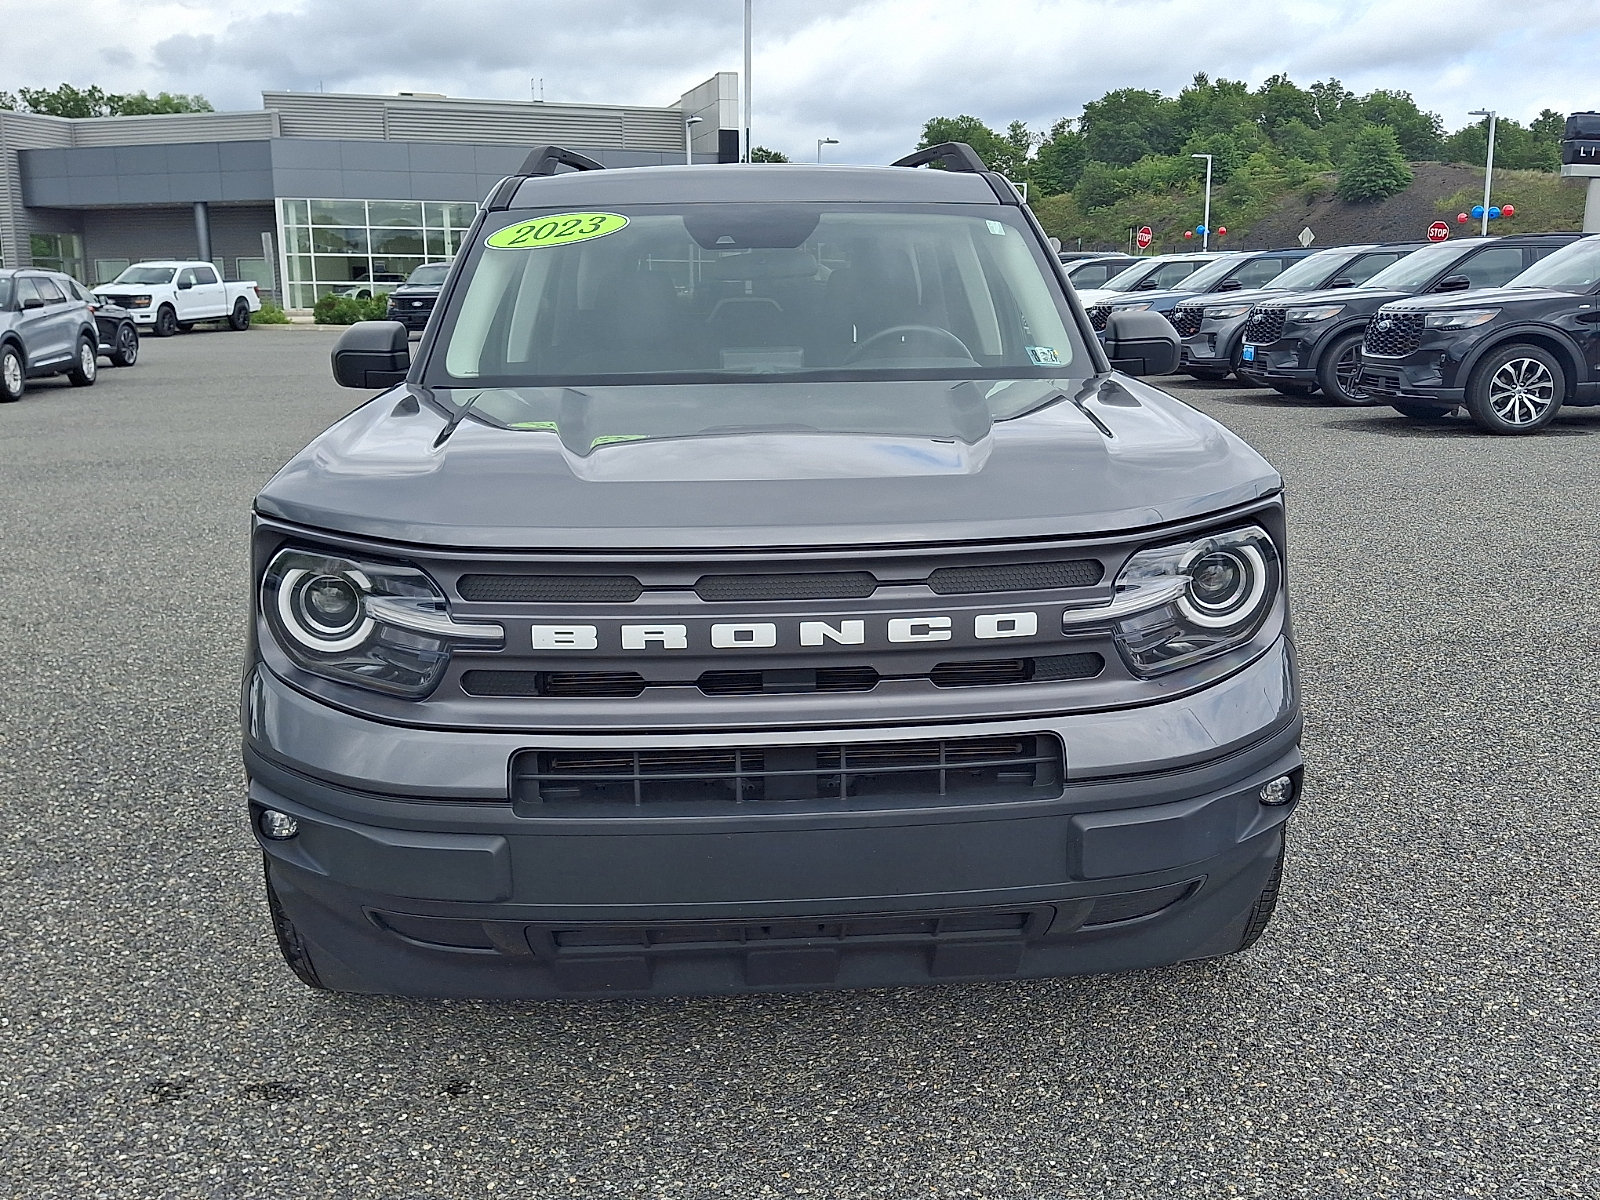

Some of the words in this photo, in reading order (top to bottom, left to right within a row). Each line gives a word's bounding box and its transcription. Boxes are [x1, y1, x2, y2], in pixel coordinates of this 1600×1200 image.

[507, 216, 607, 246] 2023
[1138, 232, 1151, 242] STOP
[1430, 228, 1447, 238] STOP
[531, 611, 1038, 650] BRONCO
